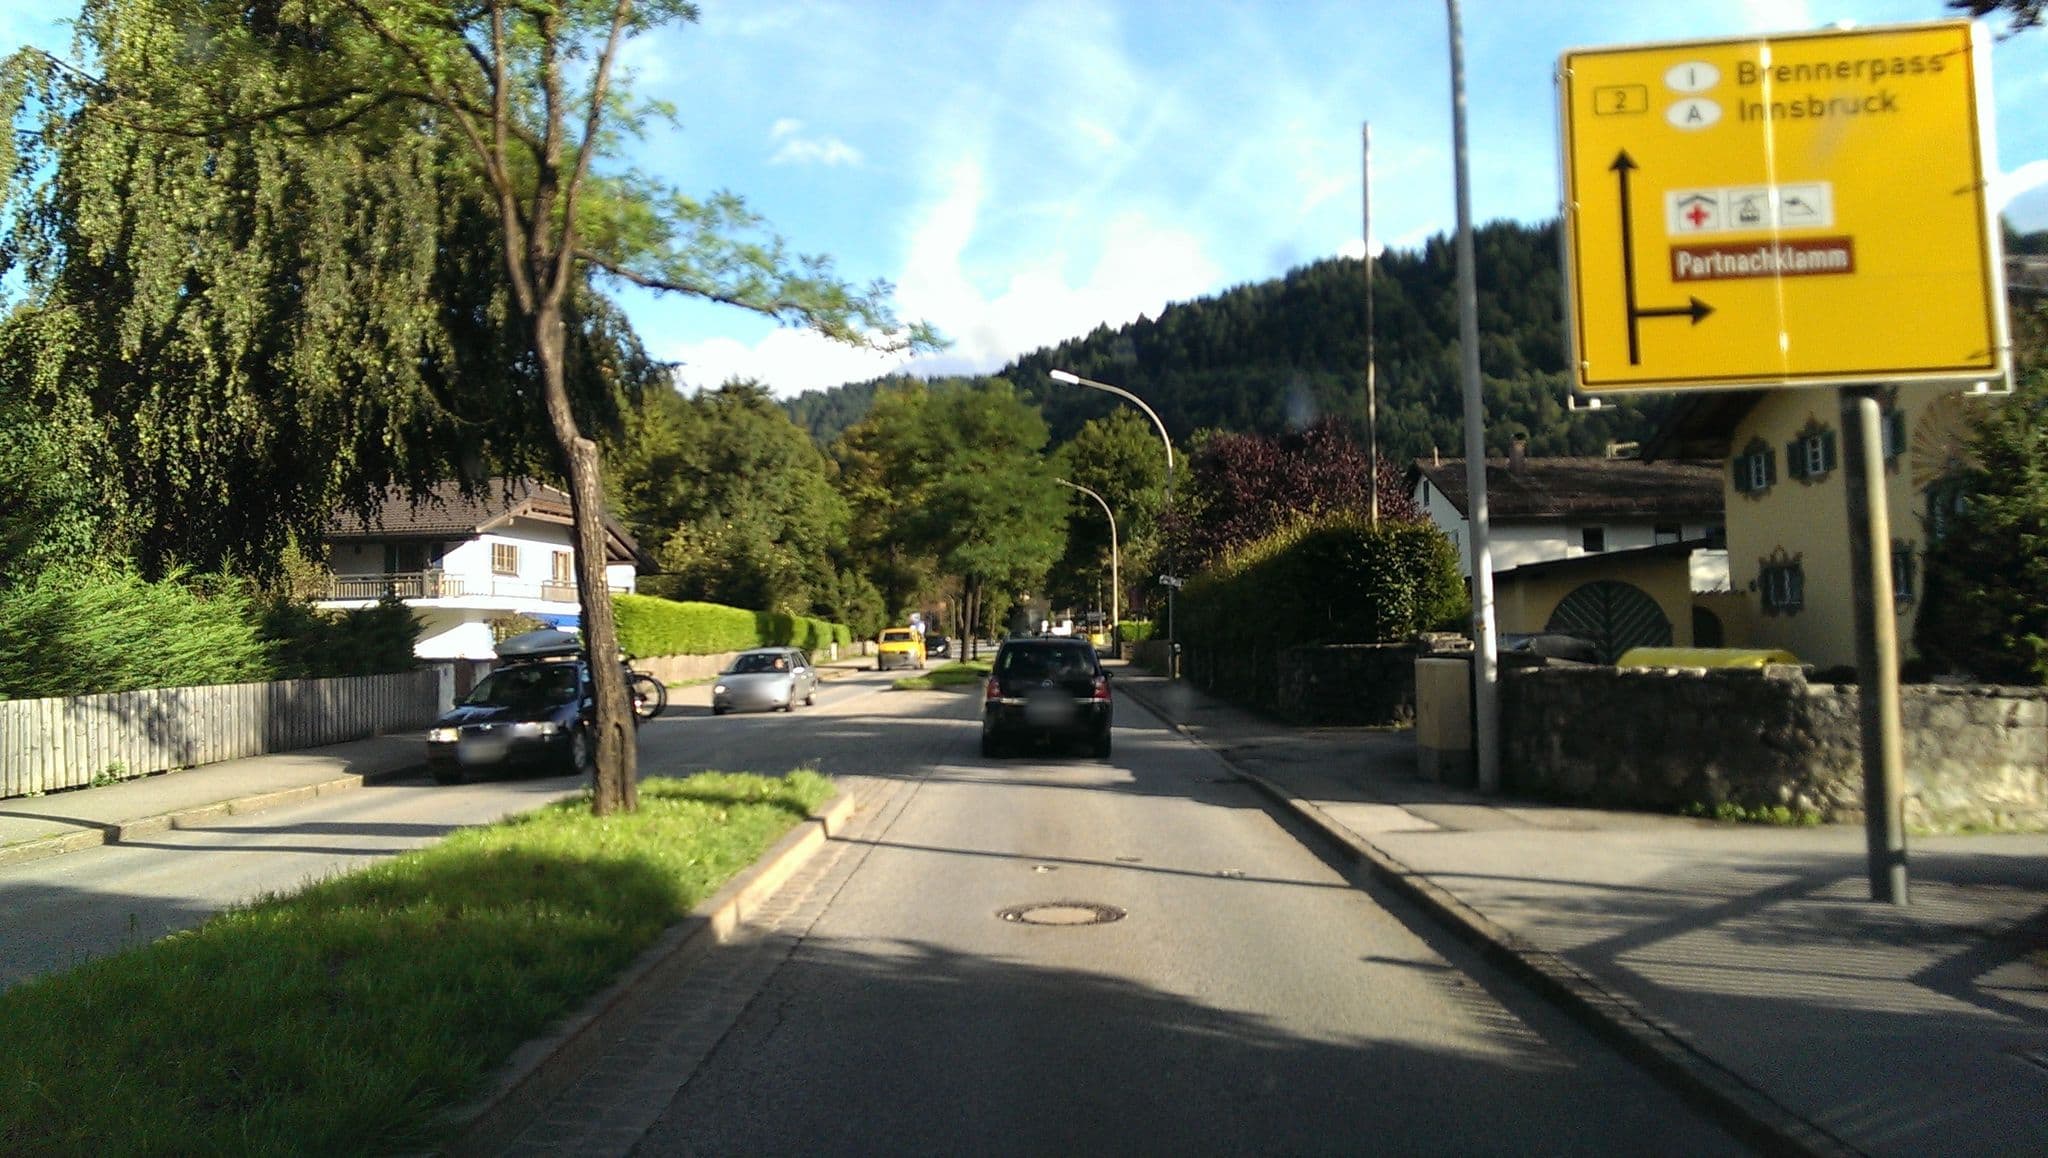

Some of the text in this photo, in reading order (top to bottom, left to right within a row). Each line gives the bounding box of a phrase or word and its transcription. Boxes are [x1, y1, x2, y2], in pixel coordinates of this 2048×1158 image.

[1737, 54, 1945, 85] Brennerpass
[1614, 90, 1627, 110] 2
[1686, 105, 1704, 123] A
[1739, 89, 1898, 121] Innsbruck
[1677, 246, 1849, 278] Partnachklamm
